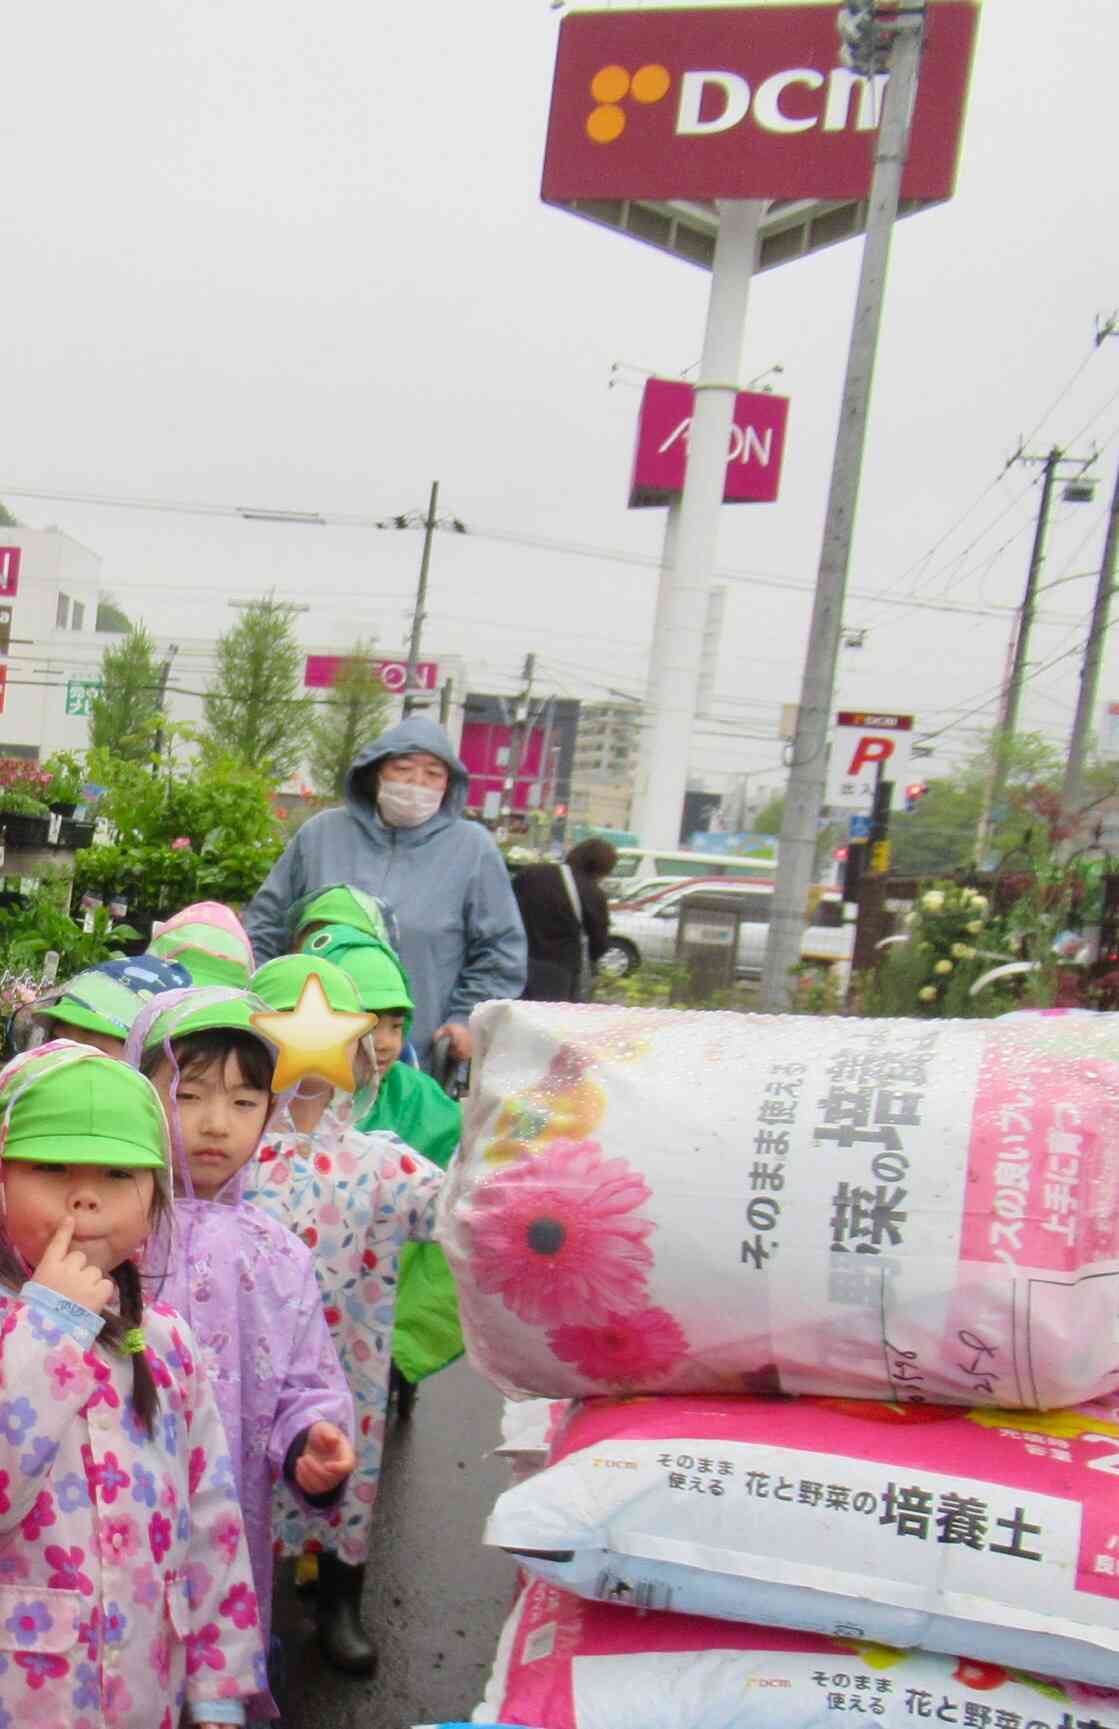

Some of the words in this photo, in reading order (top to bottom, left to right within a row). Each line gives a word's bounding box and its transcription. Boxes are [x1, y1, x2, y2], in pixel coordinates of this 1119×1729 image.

[847, 736, 896, 776] P
[657, 1453, 734, 1476] そのまま
[668, 1471, 726, 1497] 使える
[745, 1470, 1043, 1562] 花と野菜の培養土
[811, 1670, 894, 1693] そのまま
[826, 1692, 886, 1716] 使える
